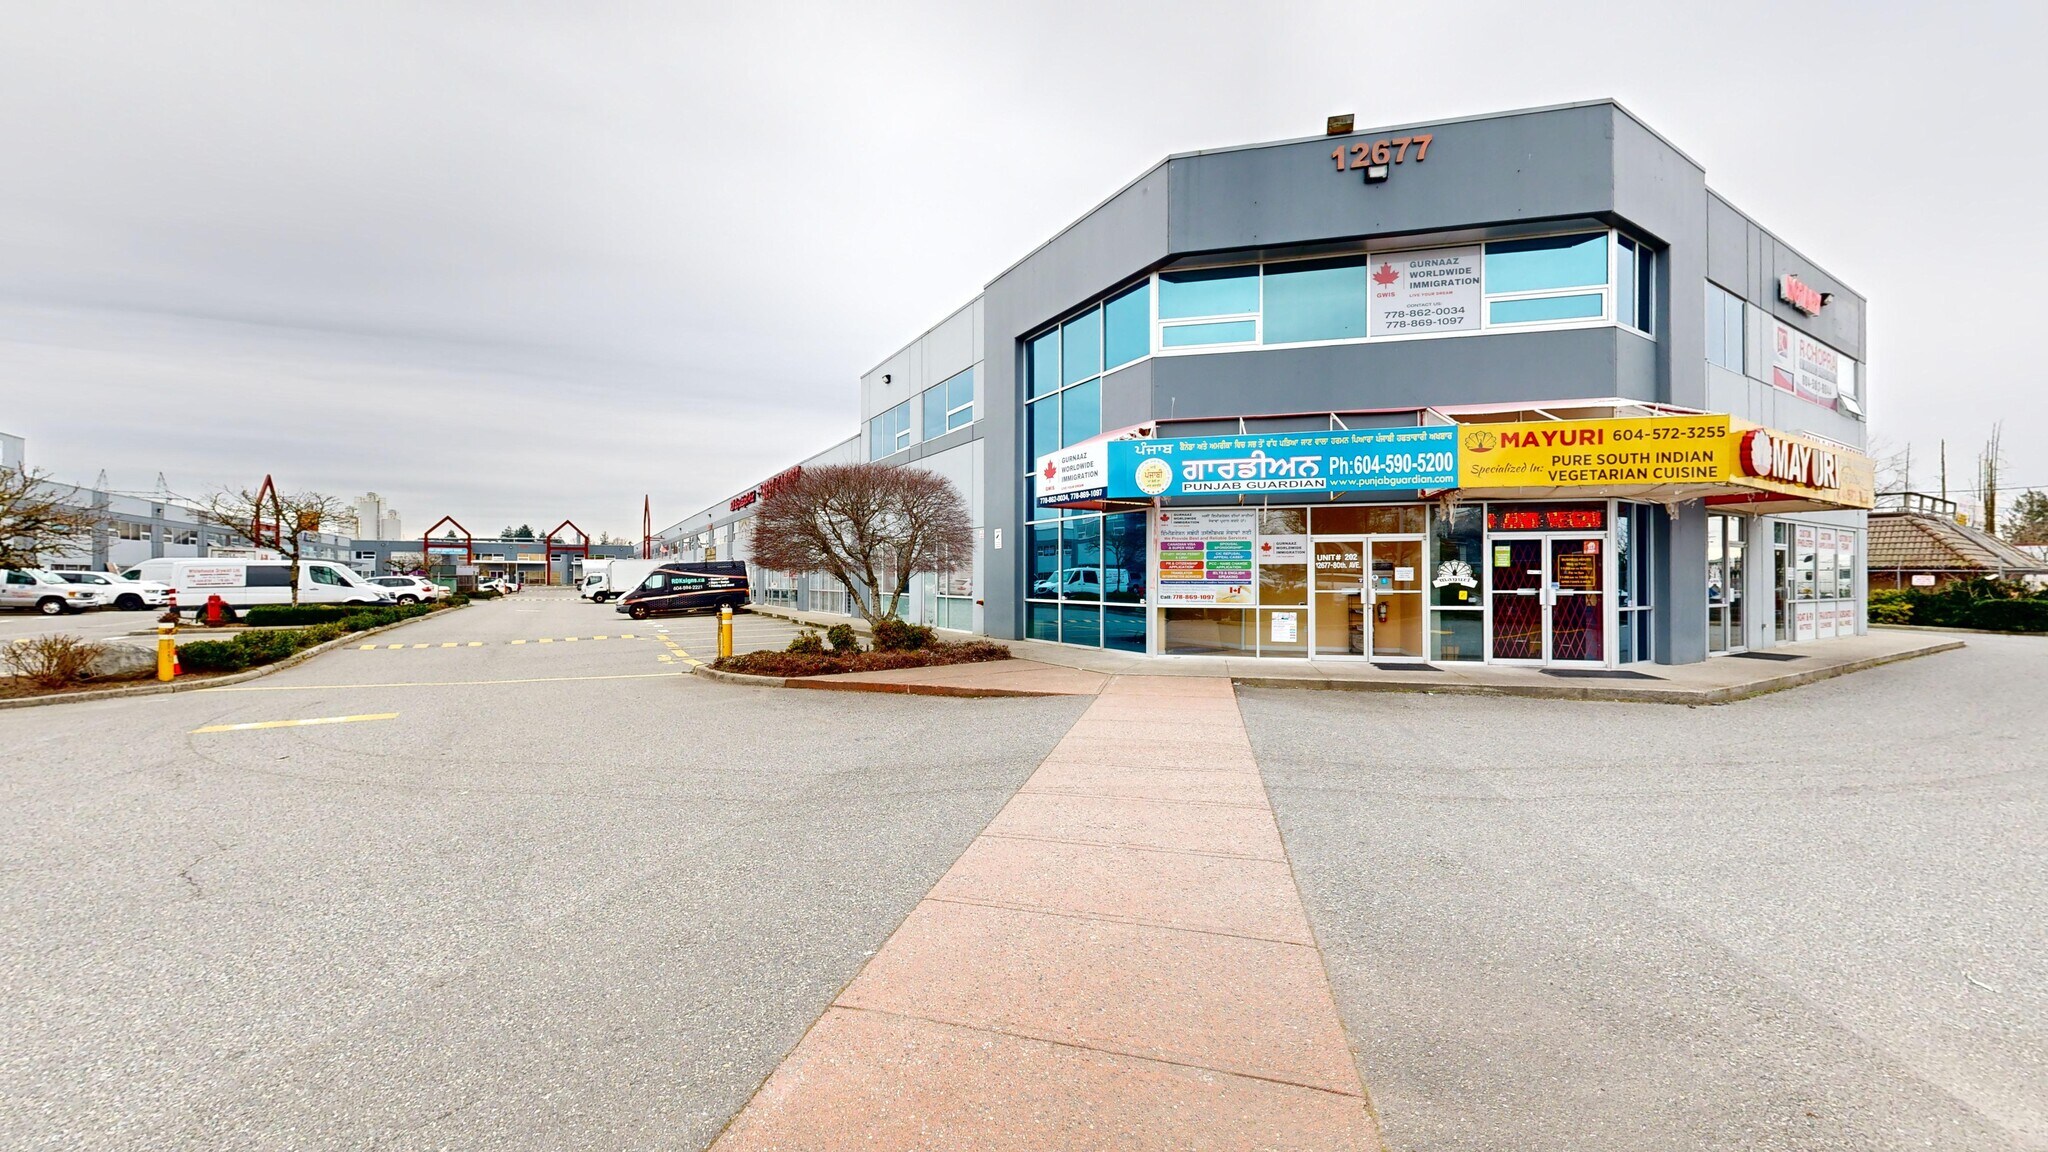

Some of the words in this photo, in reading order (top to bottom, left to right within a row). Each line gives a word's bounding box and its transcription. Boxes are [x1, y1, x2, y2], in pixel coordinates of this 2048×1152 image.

[1331, 134, 1433, 171] 12677
[1409, 258, 1460, 269] GURNAAZ
[1409, 267, 1472, 279] WORLDWIDE
[1409, 277, 1480, 289] IMMIGRATION
[1376, 291, 1396, 299] GWIS
[1384, 306, 1465, 319] 778-862-0034
[1385, 317, 1464, 329] 778-869-1097
[1500, 428, 1604, 448] MAYURI
[1612, 426, 1726, 442] 604-572-3255
[1134, 442, 1174, 456] ਪੰਜਾਬ
[1061, 452, 1087, 464] GURNAAZ
[1329, 451, 1454, 476] Ph:604-590-5200
[1552, 453, 1593, 467] PURE
[1596, 452, 1650, 465] SOUTH
[1655, 450, 1713, 464] INDIAN
[1772, 437, 1840, 489] MAYURI
[1061, 461, 1094, 473] WORLDWIDE
[1181, 449, 1322, 481] ਗਾਰਡੀਅਨ
[1470, 463, 1527, 478] Specialized
[1529, 463, 1544, 473] In:
[1061, 470, 1099, 483] IMMIGRATION
[1549, 468, 1648, 482] VEGETARIAN
[1652, 465, 1718, 479] CUISINE
[1183, 481, 1241, 491] PUNJAB
[1246, 479, 1325, 490] GUARDIAN
[1329, 475, 1454, 487] www.punjabguardian.com
[1344, 553, 1358, 561] 202
